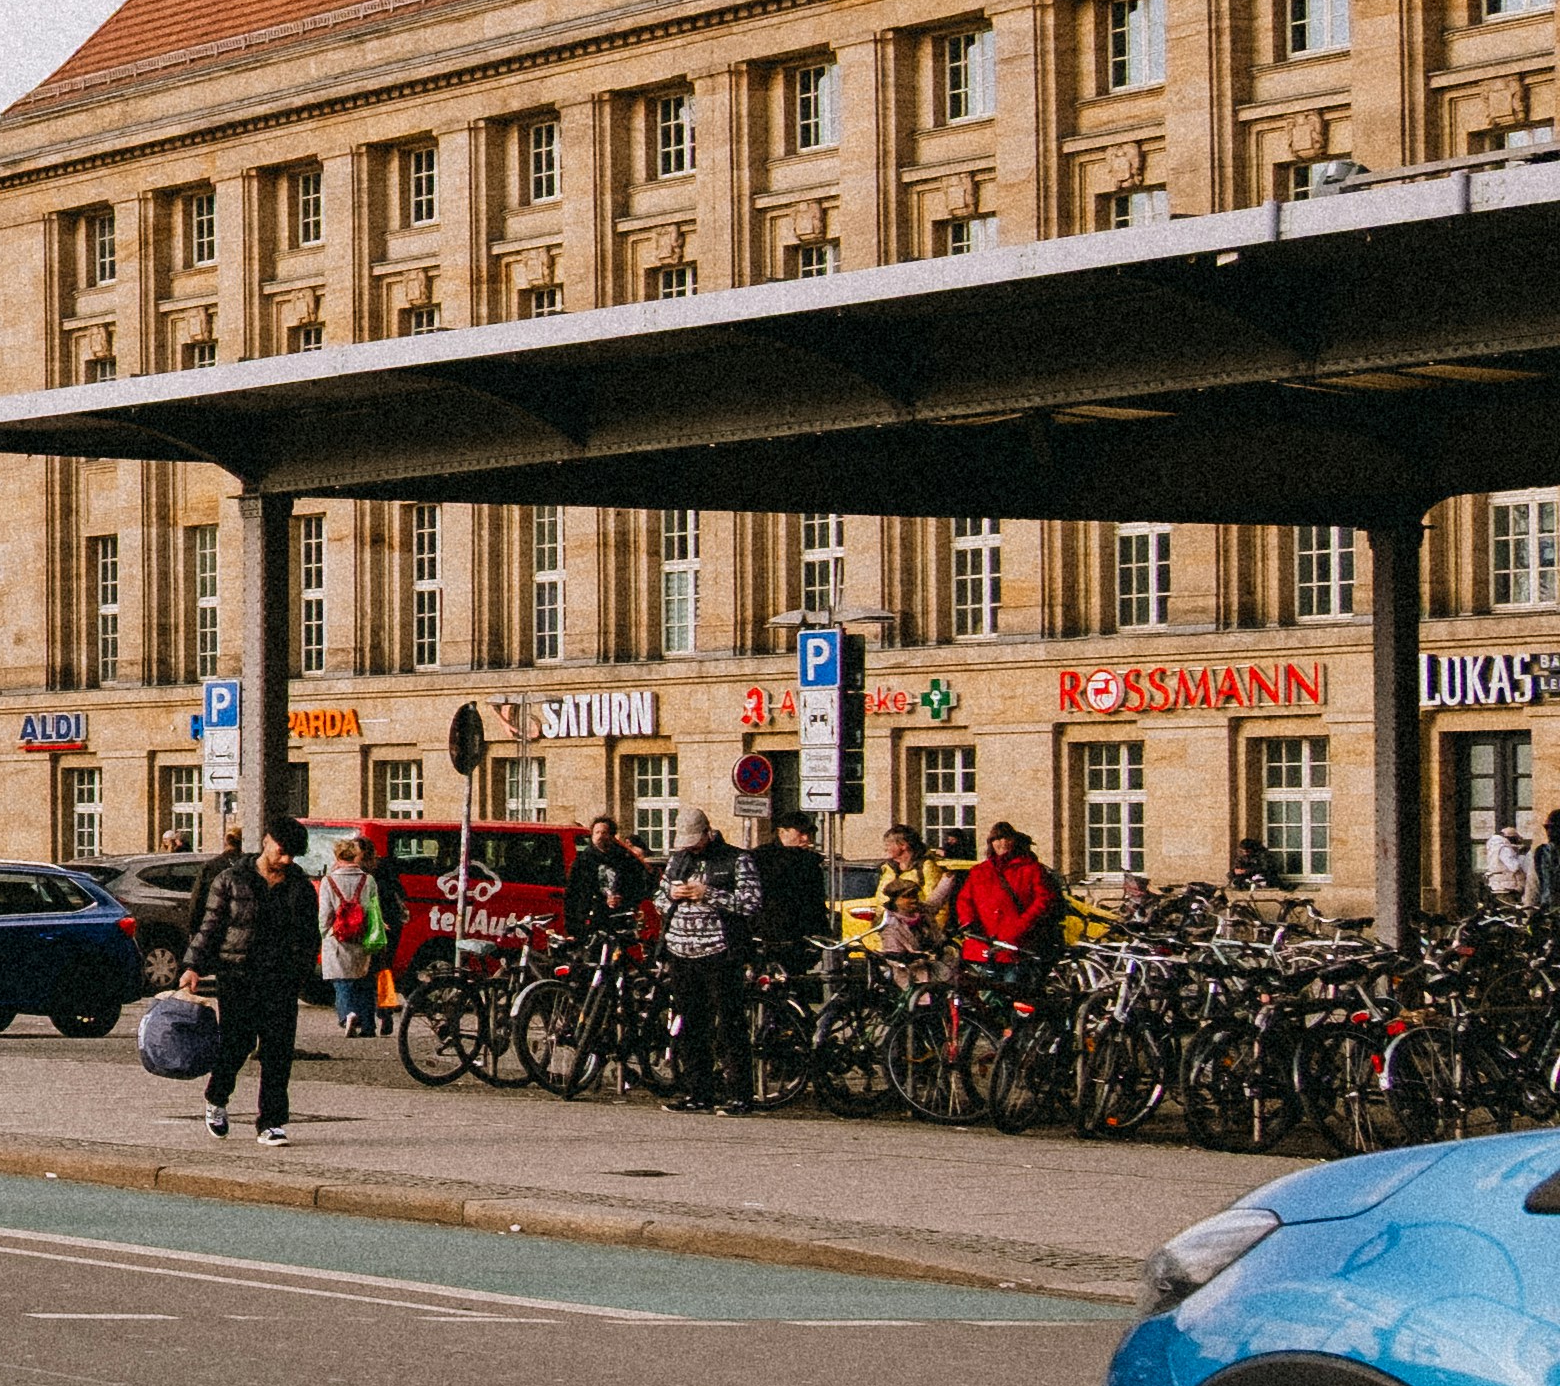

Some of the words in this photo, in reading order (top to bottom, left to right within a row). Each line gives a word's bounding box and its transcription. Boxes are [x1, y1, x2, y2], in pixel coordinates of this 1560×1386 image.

[806, 638, 830, 681] P
[1419, 653, 1532, 706] LUKAS
[211, 687, 230, 723] P
[1060, 661, 1321, 713] ROSSMANN
[19, 714, 84, 741] ALDI
[287, 709, 360, 738] PARDA
[541, 692, 654, 739] SATURN
